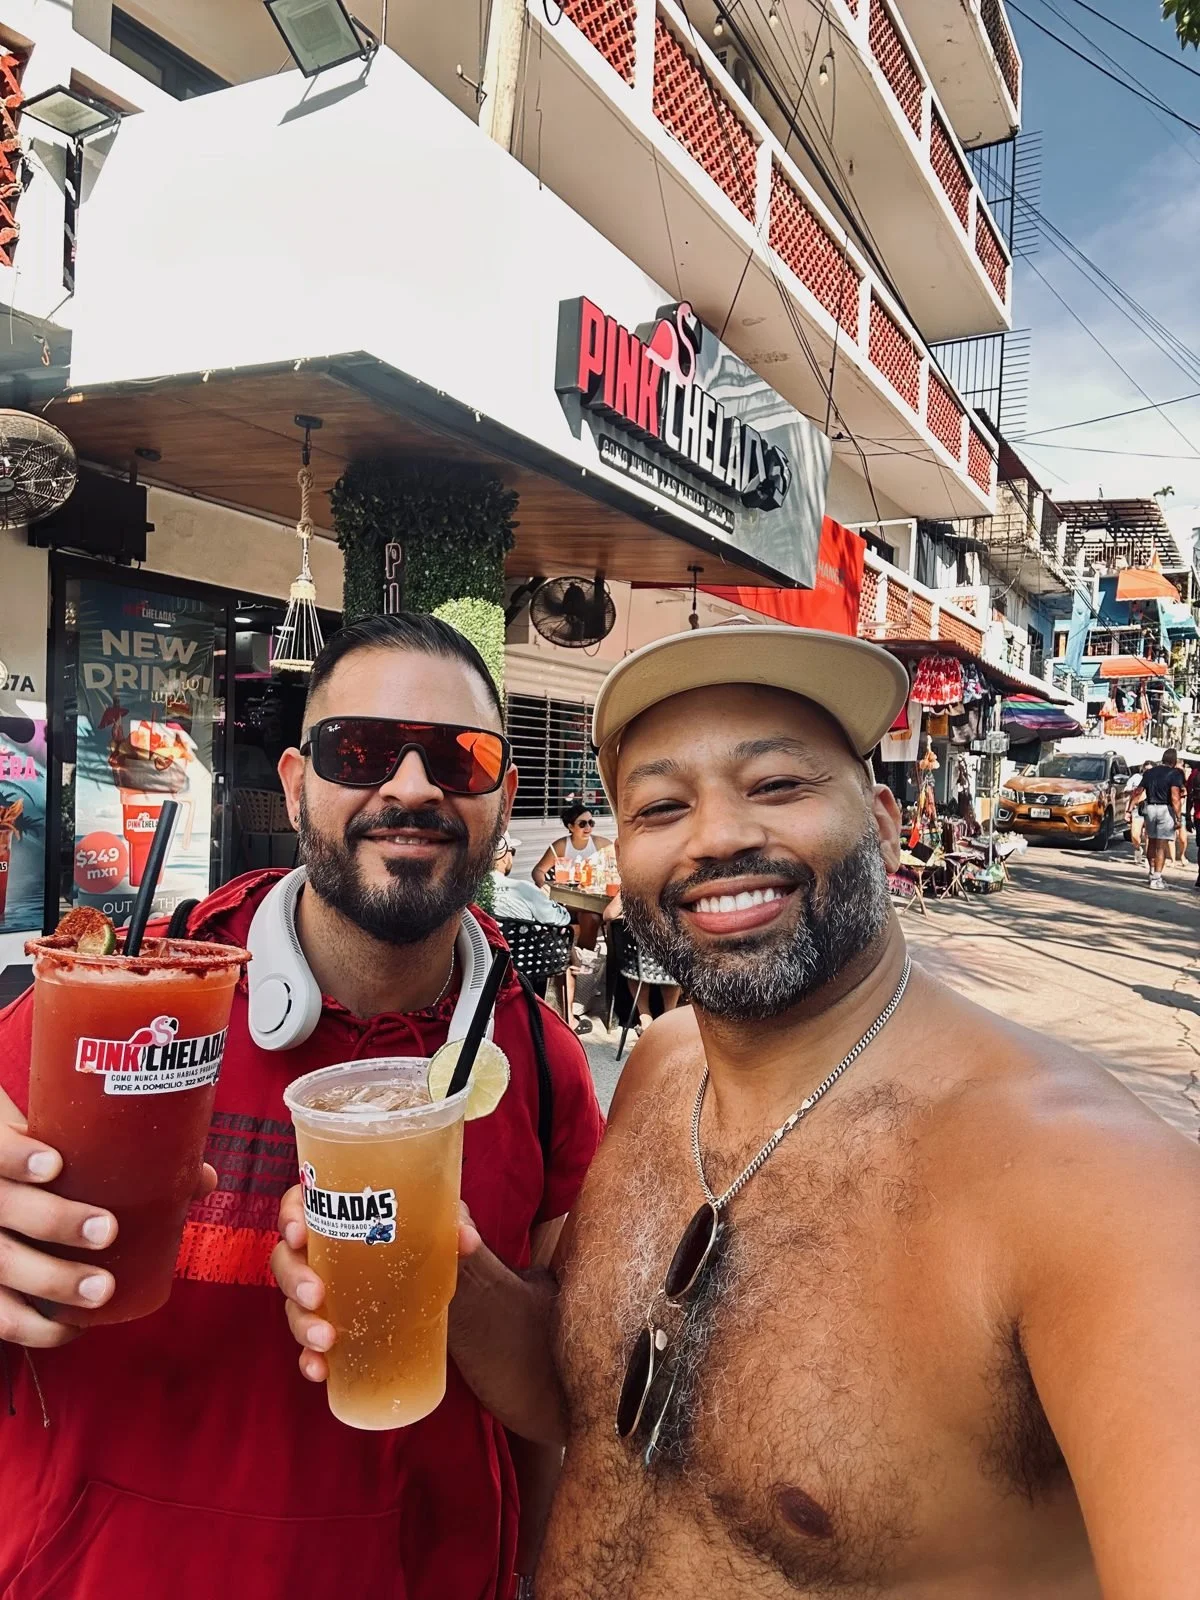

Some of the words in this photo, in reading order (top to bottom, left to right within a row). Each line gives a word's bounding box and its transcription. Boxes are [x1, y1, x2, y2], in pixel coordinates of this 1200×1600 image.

[577, 295, 662, 438] PINK
[101, 629, 198, 664] NEW
[76, 848, 119, 868] $249
[87, 867, 118, 880] mxn
[102, 900, 133, 914] OUT
[80, 1039, 141, 1071] PINK
[111, 1074, 131, 1082] COMO
[134, 1073, 158, 1082] NUNCA
[161, 1072, 175, 1080] LAS
[134, 1083, 141, 1091] A
[305, 1187, 393, 1221] CHELADAS
